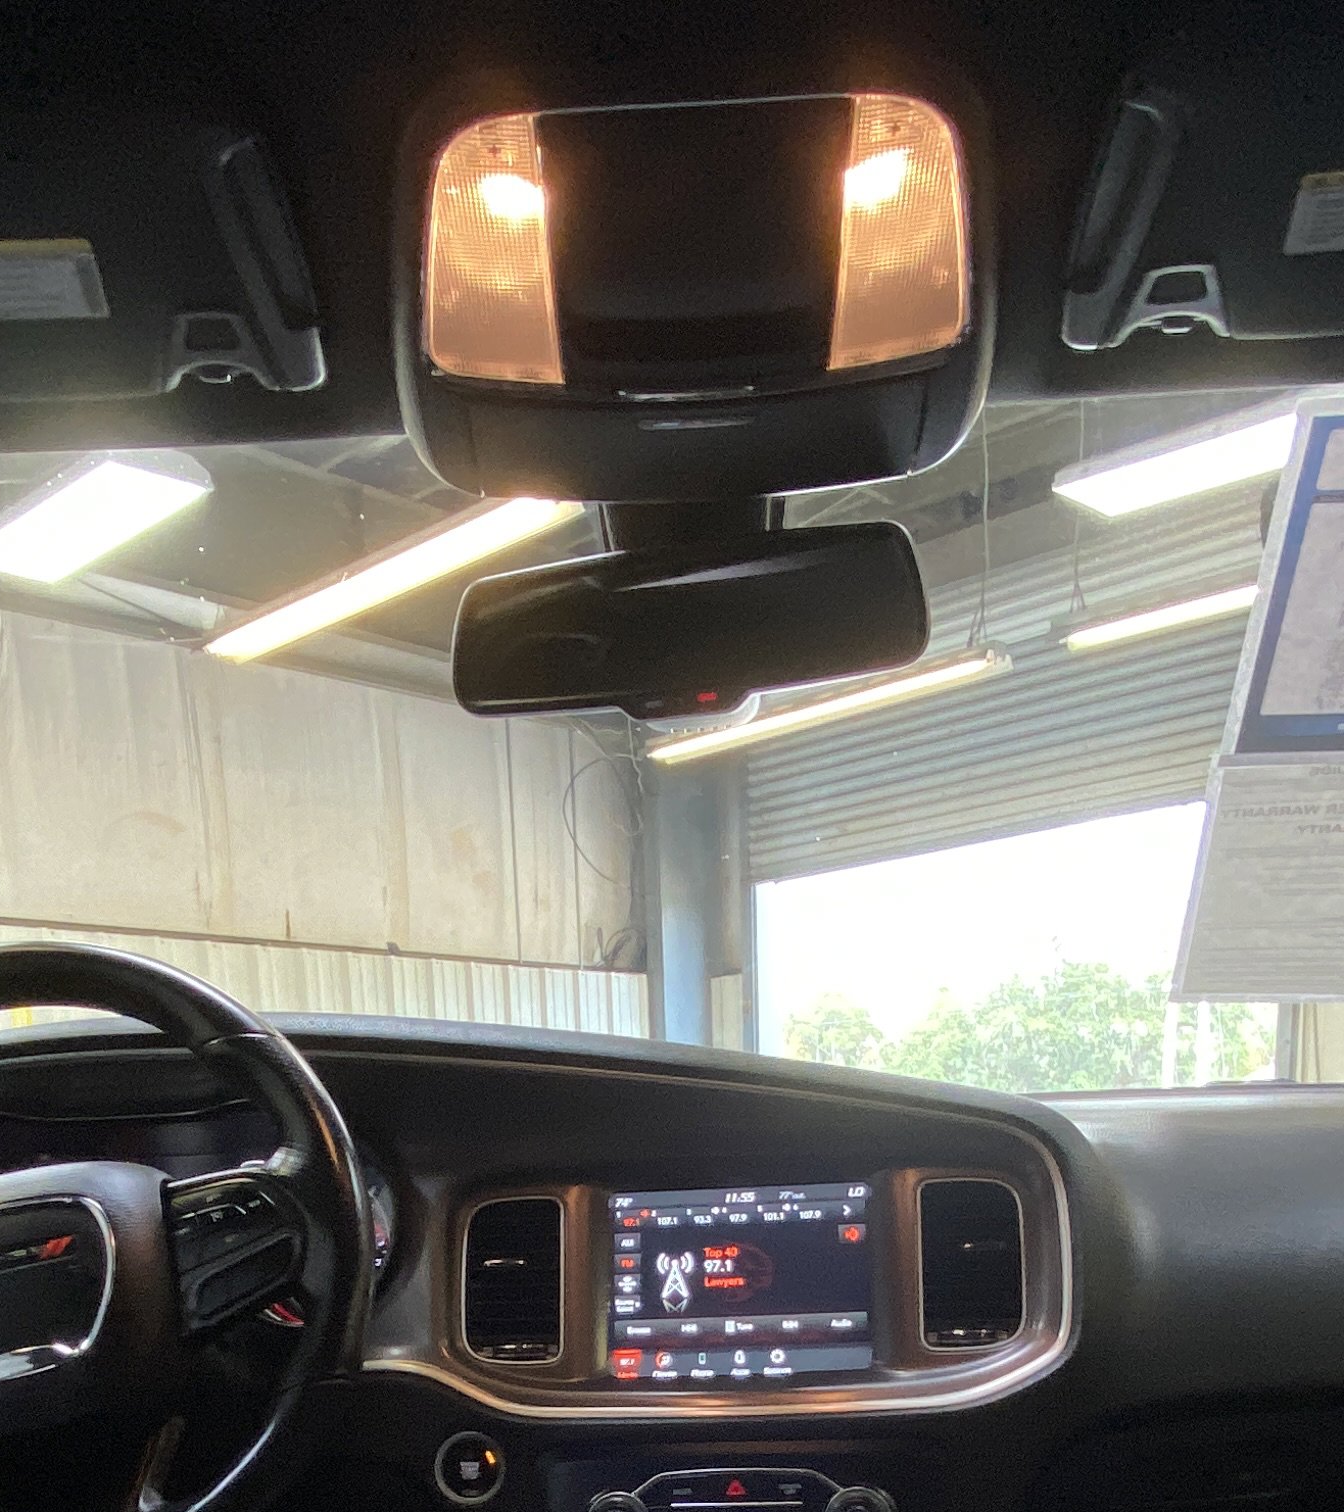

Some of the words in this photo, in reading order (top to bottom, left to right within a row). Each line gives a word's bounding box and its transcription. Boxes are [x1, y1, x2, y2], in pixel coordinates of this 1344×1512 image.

[724, 1191, 756, 1204] 11:55
[763, 1211, 785, 1221] 101.1
[798, 1209, 823, 1220] 107.9
[657, 1216, 679, 1227] 107.1
[703, 1246, 723, 1259] Top
[703, 1259, 733, 1273] 97.1
